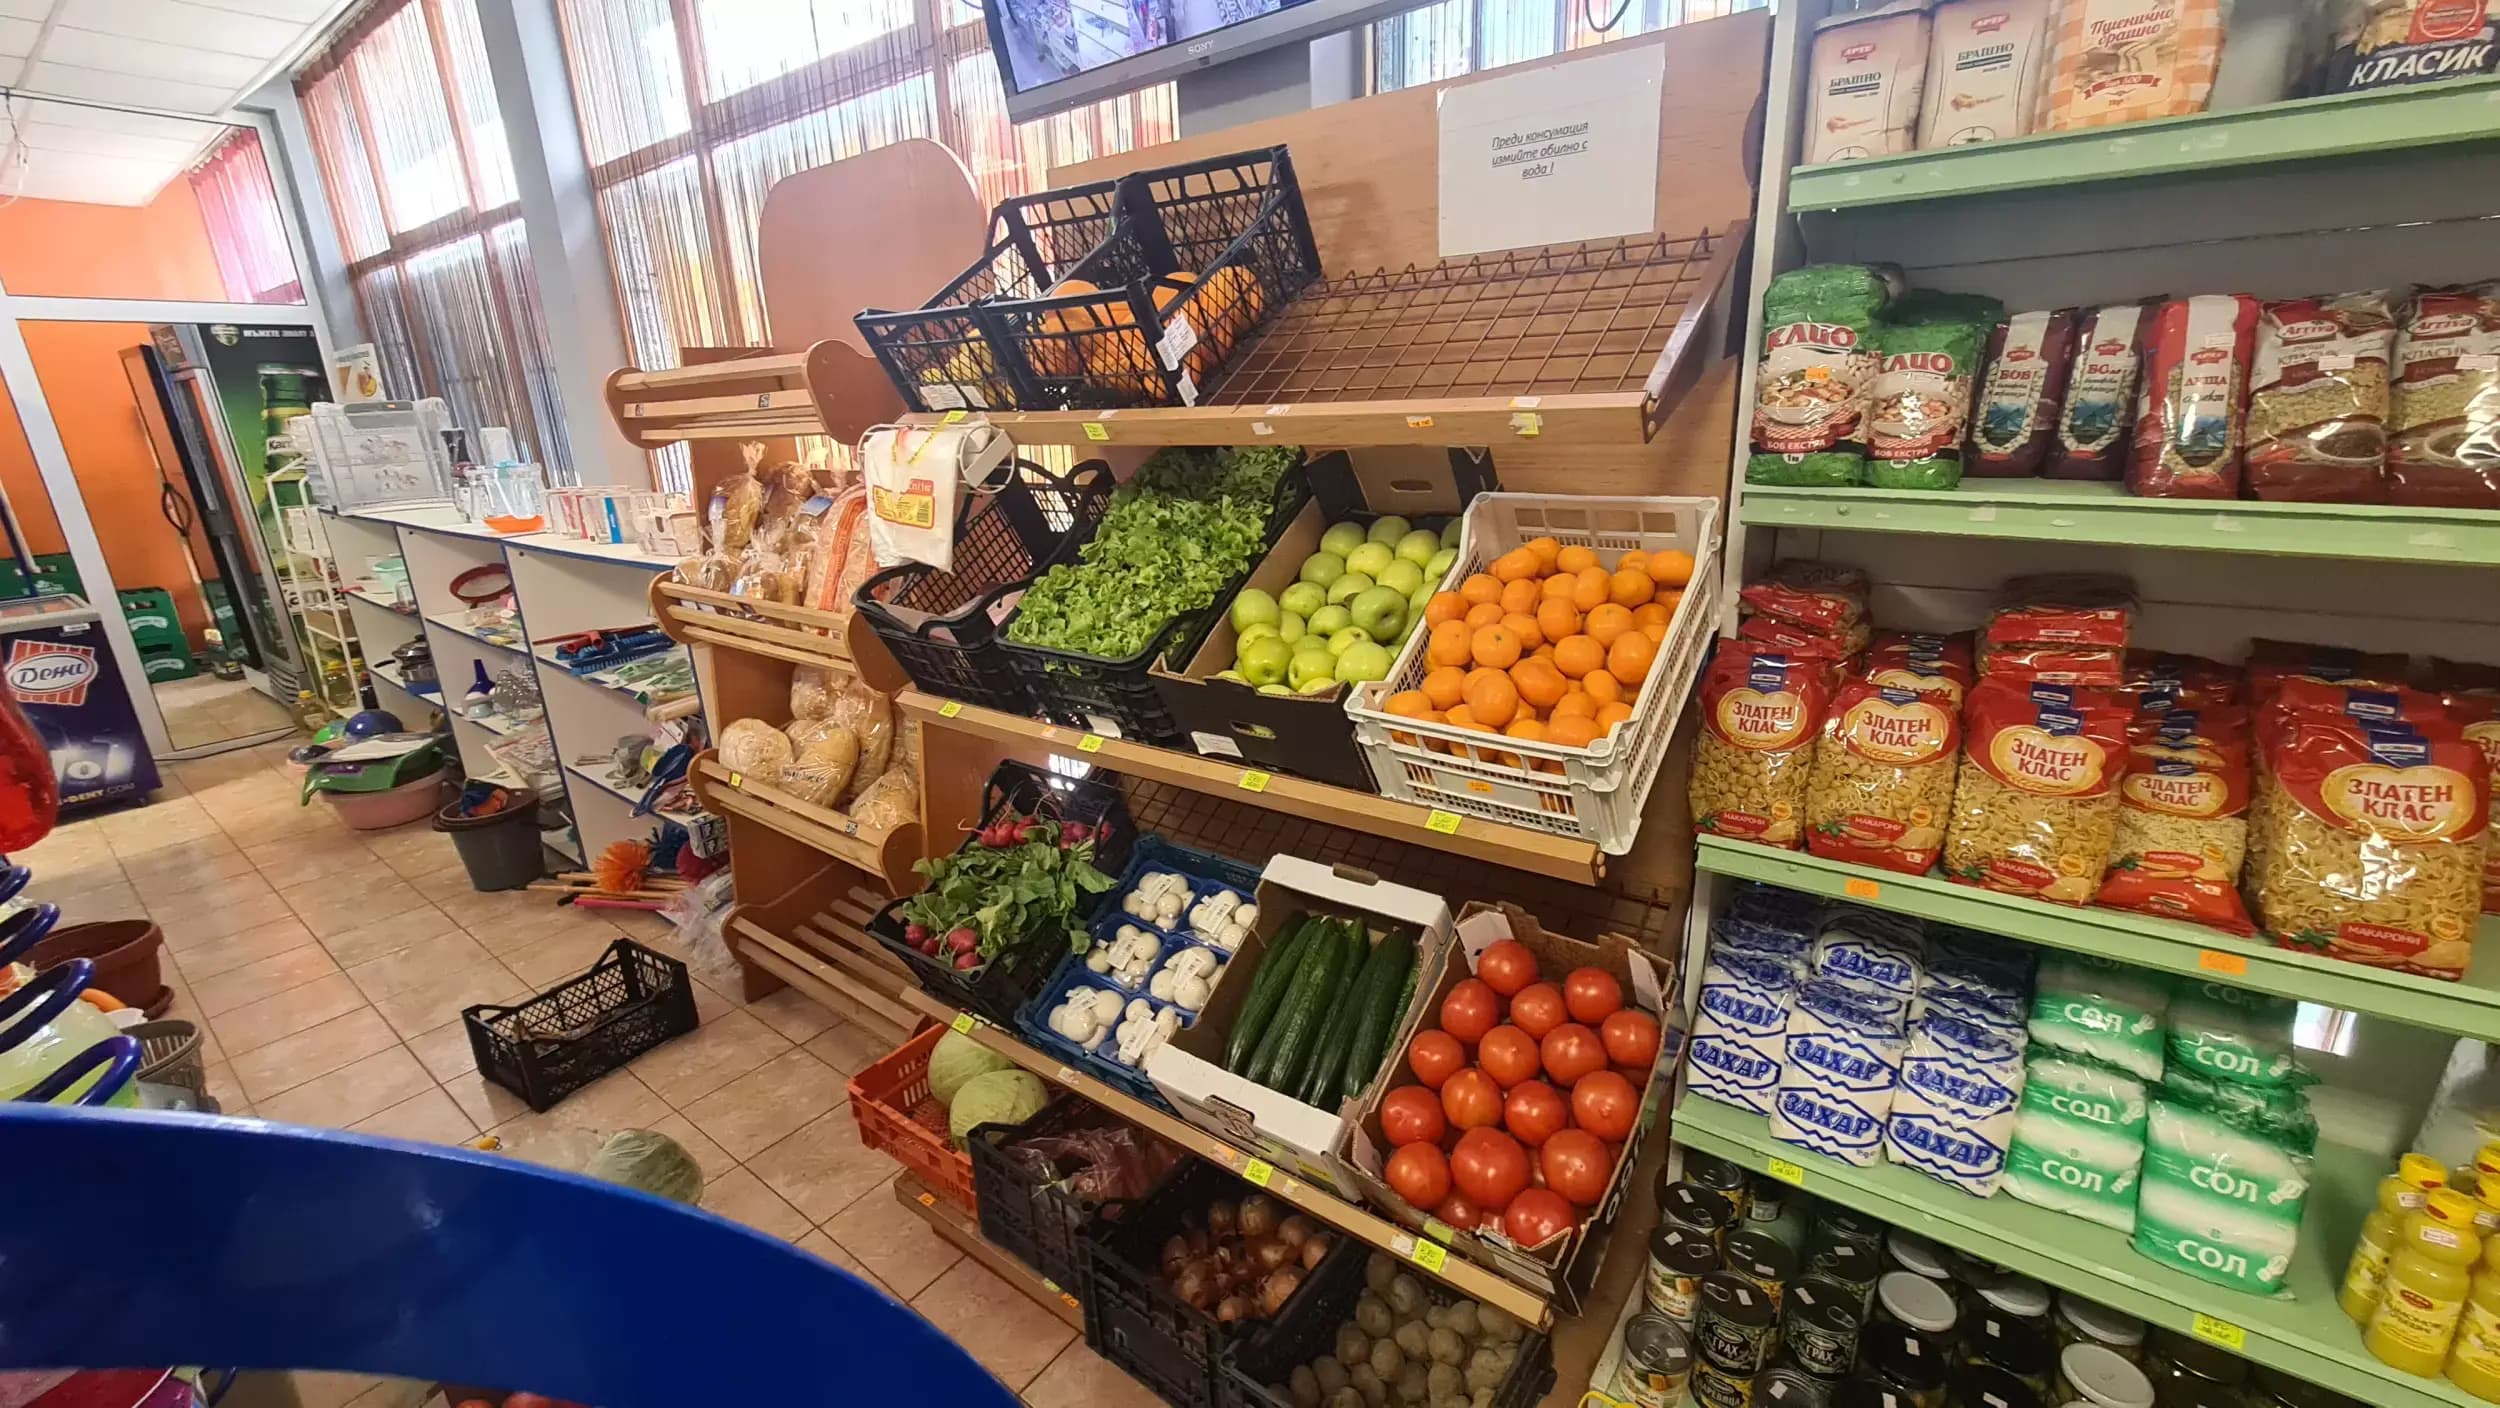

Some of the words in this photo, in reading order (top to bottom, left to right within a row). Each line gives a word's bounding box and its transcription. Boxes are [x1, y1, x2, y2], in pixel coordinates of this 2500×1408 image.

[2090, 8, 2174, 35] Пшенично
[1188, 40, 1213, 54] SONY
[1957, 42, 2015, 61] БРАШНО
[2349, 45, 2493, 87] КЛАСИК
[1830, 72, 1881, 87] БРАШНО
[1492, 133, 1524, 148] Преди
[1525, 122, 1588, 141] консумация
[1492, 149, 1538, 165] измийте
[1540, 143, 1580, 157] обилно
[1521, 164, 1547, 177] вода
[1733, 701, 1792, 720] ЗЛАТЕН
[1863, 710, 1931, 732] ЗЛАТЕН
[1738, 717, 1781, 734] КЛАС
[1869, 728, 1919, 748] КЛАС
[2011, 738, 2089, 767] ЗЛАТЕН
[2017, 758, 2072, 782] КЛАС
[2140, 776, 2211, 794] ЗЛАТЕН
[2347, 778, 2454, 803] ЗЛАТЕН
[2150, 789, 2200, 807] КЛАС
[2363, 797, 2436, 822] КЛАС
[2347, 925, 2421, 945] МАКАРОНИ
[1828, 947, 1912, 985] ЗАХАР
[1704, 989, 1780, 1028] ЗАХАР
[2064, 1003, 2123, 1033] СОЛ
[1692, 1040, 1772, 1081] ЗАХАР
[1795, 1039, 1884, 1082] ЗАХАР
[2195, 1046, 2260, 1076] СОЛ
[1907, 1063, 2006, 1109] ЗАХАР
[1783, 1092, 1873, 1139] ЗАХАР
[2051, 1095, 2111, 1122] СОЛ
[1894, 1119, 1994, 1167] ЗАХАР
[2042, 1160, 2103, 1192] СОЛ
[2189, 1167, 2258, 1204] СОЛ
[2178, 1239, 2248, 1281] СОЛ
[1712, 1337, 1740, 1357] ГРАХ
[1806, 1344, 1834, 1362] ГРАХ
